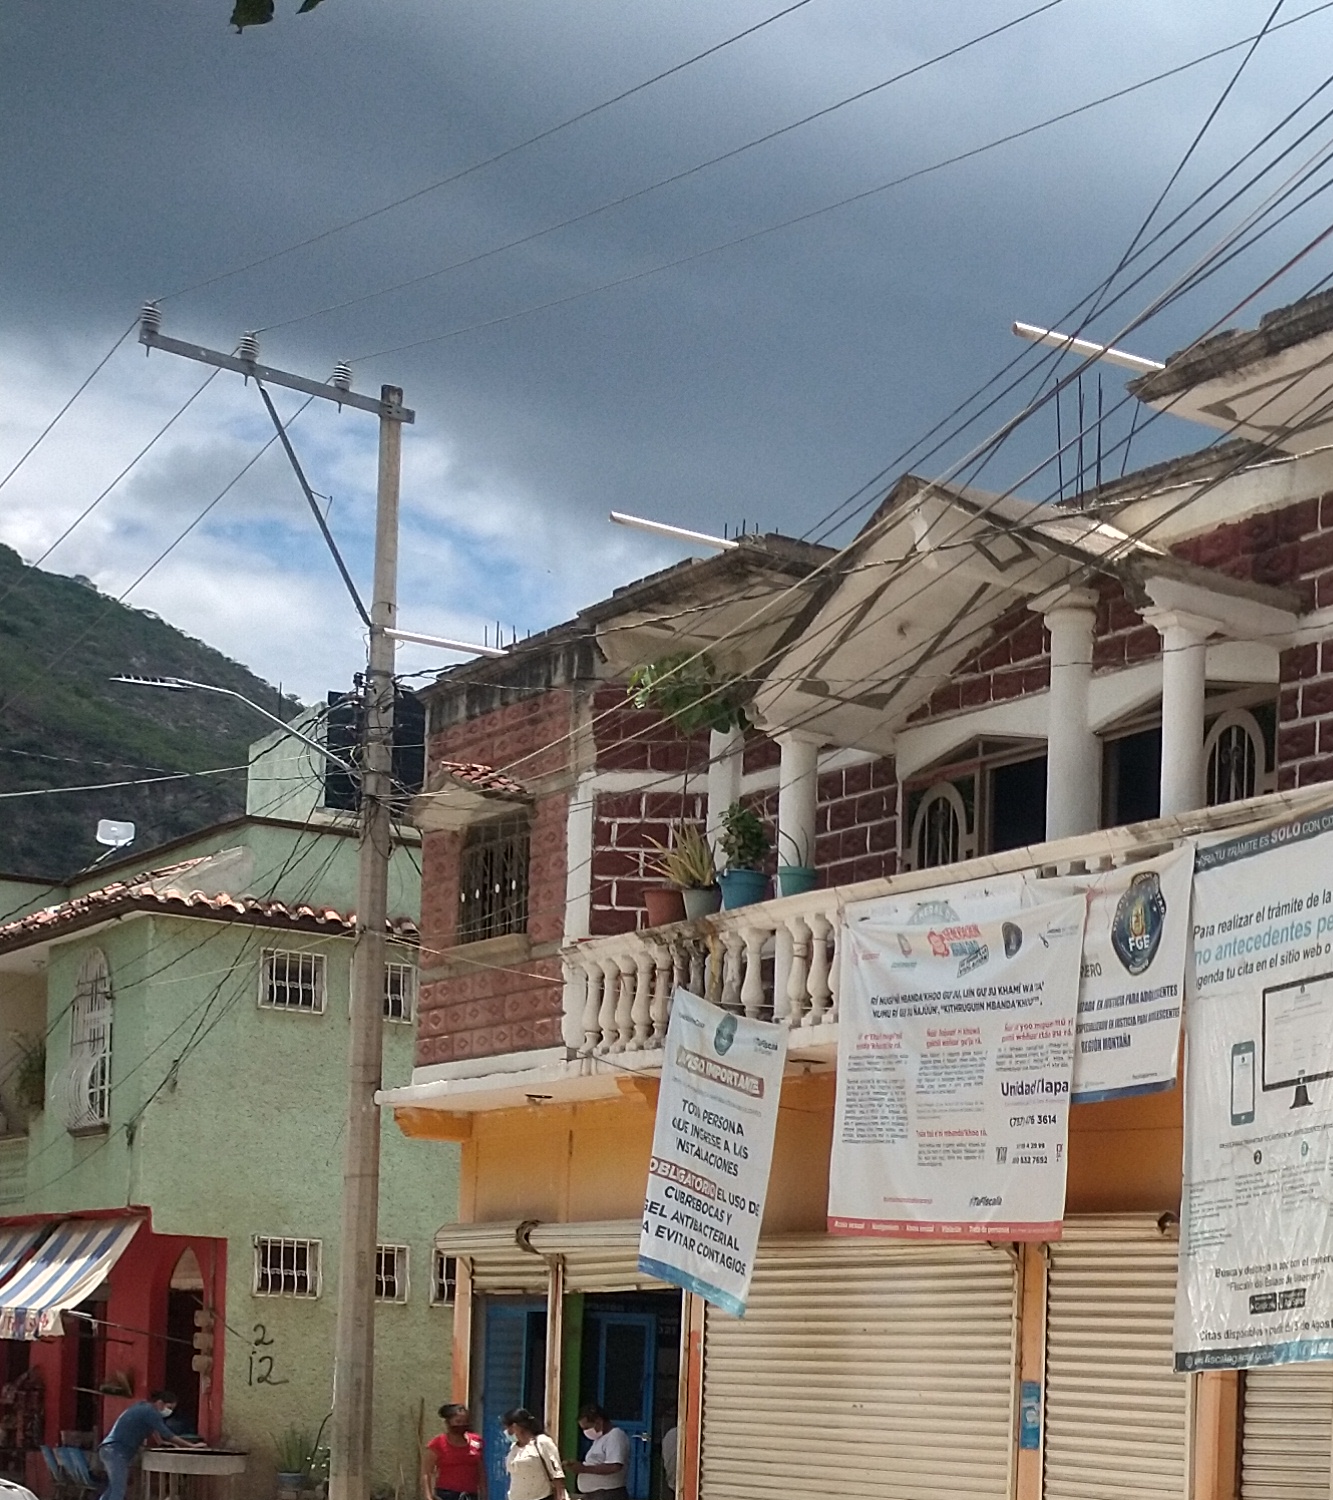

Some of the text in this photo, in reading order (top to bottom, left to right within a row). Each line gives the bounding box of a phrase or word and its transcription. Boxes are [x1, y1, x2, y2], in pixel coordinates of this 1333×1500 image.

[1271, 822, 1300, 845] SOLO
[1302, 819, 1321, 835] CON
[1193, 924, 1215, 941] Para
[1217, 912, 1254, 937] realizar
[1256, 909, 1265, 923] el
[1267, 897, 1303, 922] trámite
[1306, 892, 1319, 908] de
[1322, 888, 1332, 906] la
[1128, 934, 1151, 952] FGE
[1215, 921, 1312, 961] antecedentes
[1196, 970, 1224, 991] genda
[1226, 966, 1235, 980] tu
[1237, 961, 1254, 977] cita
[1256, 959, 1267, 972] en
[1269, 952, 1278, 968] el
[1280, 949, 1300, 967] sitio
[1303, 942, 1322, 962] web
[1324, 943, 1331, 954] o
[1001, 1079, 1036, 1097] Unidad
[702, 1109, 744, 1137] PERSONA
[1037, 1114, 1057, 1125] 3614
[723, 1140, 731, 1154] A
[664, 1184, 733, 1226] CUBREBOCAS Y
[716, 1187, 727, 1204] EL
[728, 1192, 746, 1211] USO
[654, 1224, 697, 1252] EVITAR
[670, 1209, 740, 1252] ANTIBACTERIAL
